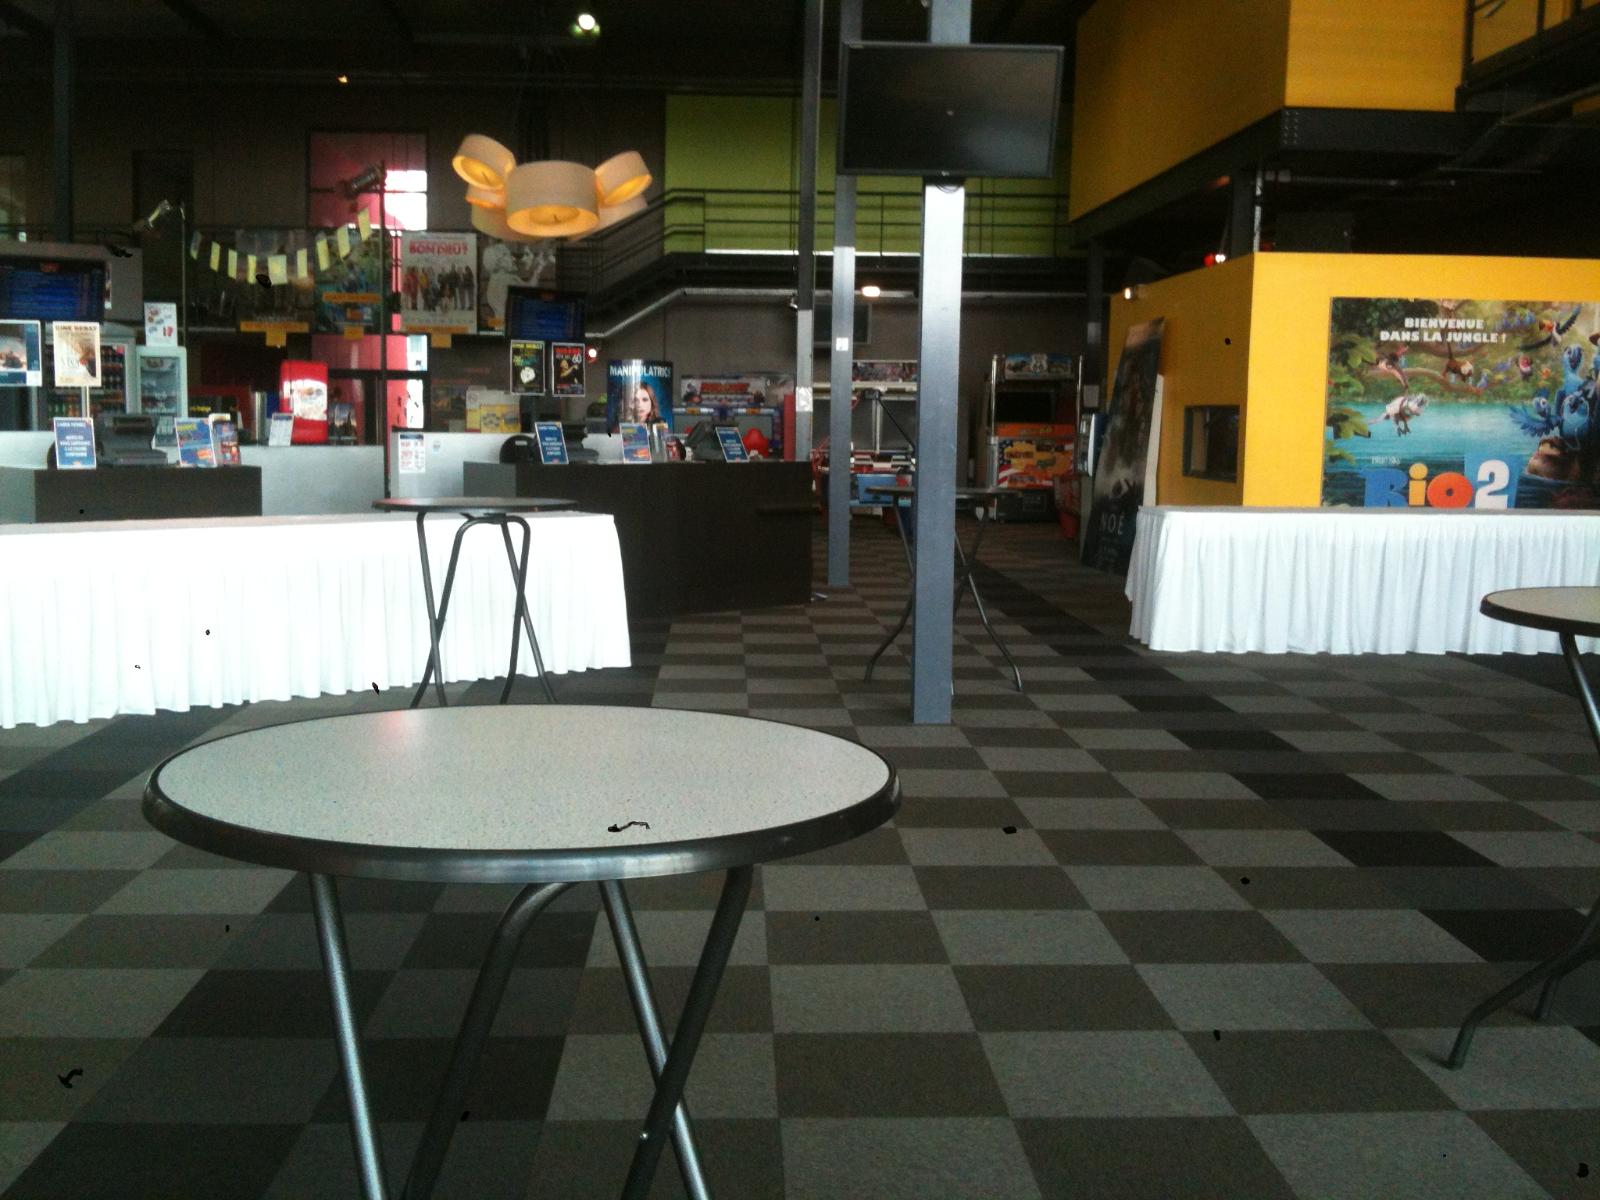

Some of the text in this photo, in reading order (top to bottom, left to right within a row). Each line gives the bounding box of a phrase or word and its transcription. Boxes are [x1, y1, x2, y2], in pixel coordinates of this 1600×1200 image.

[1404, 317, 1484, 329] BIENVENUE
[1380, 330, 1420, 342] DANS
[1423, 330, 1442, 342] LA
[1446, 332, 1498, 343] JUNGLE
[609, 364, 671, 378] MANIULATRIC
[1474, 459, 1510, 509] 2
